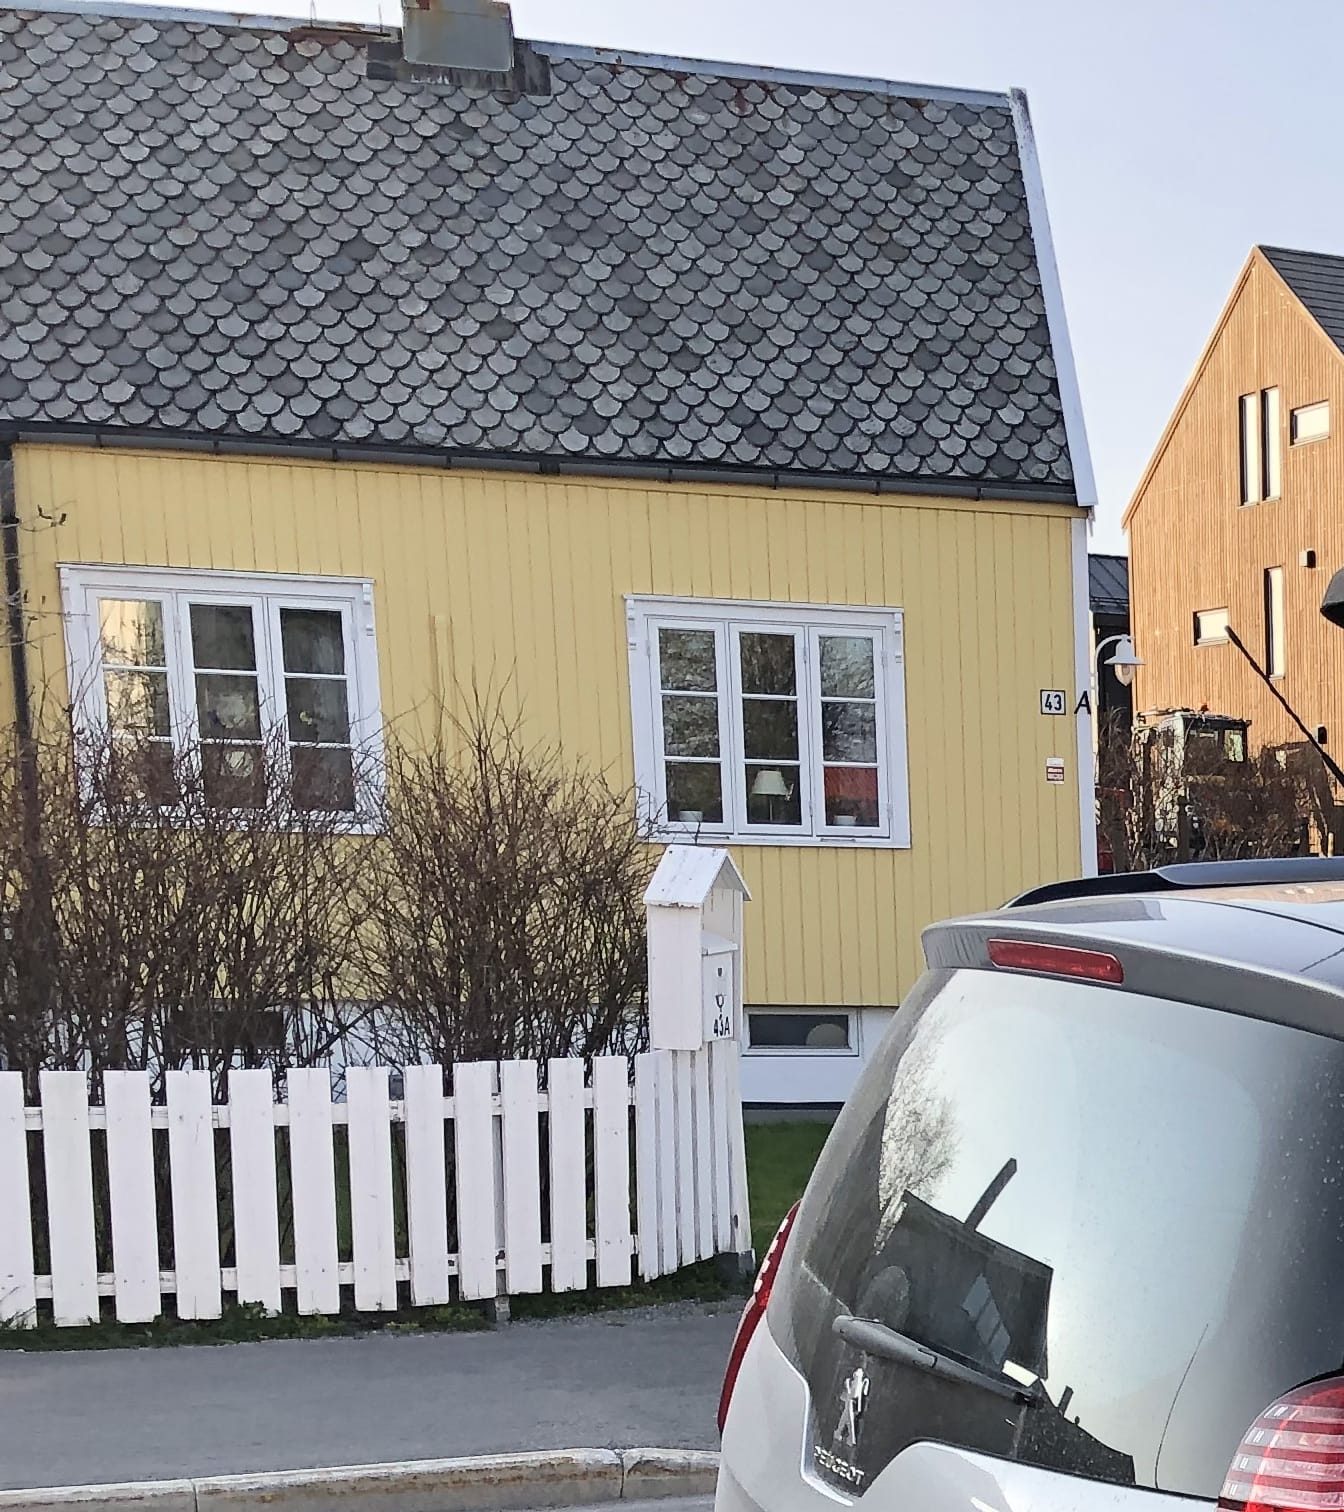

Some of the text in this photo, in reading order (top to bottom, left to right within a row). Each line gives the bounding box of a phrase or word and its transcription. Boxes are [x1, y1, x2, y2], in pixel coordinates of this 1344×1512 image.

[1045, 690, 1091, 714] 43 A
[814, 1446, 864, 1486] PEUGEOT
